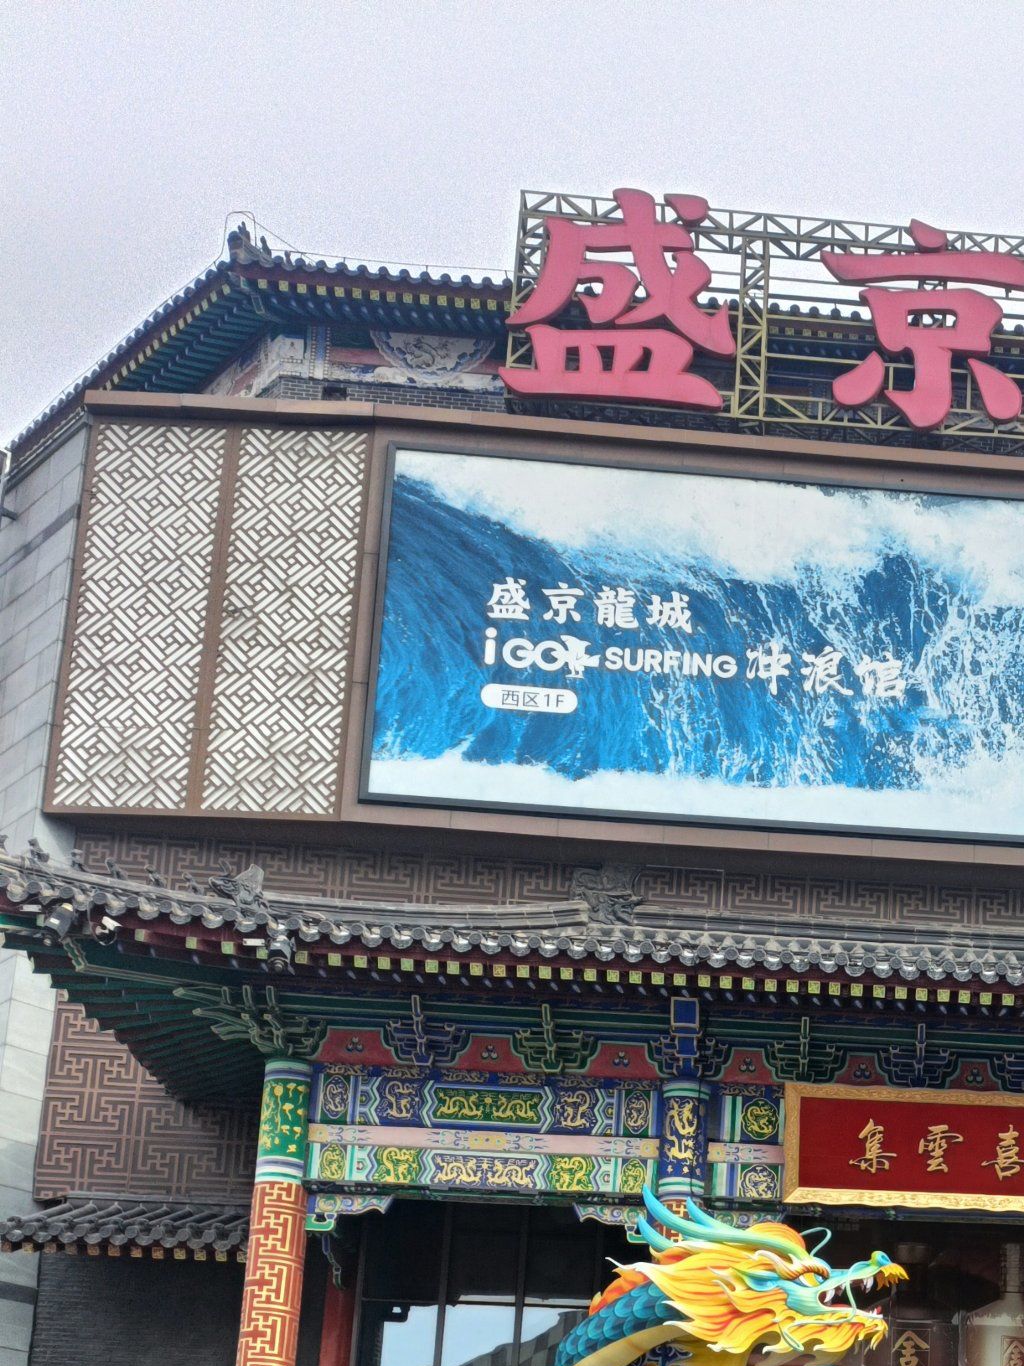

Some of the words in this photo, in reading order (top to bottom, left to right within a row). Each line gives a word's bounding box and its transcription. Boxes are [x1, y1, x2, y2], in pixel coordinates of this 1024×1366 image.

[486, 577, 693, 635] 盛京龍城
[605, 646, 737, 679] SURFING
[501, 689, 566, 709] 西区1F
